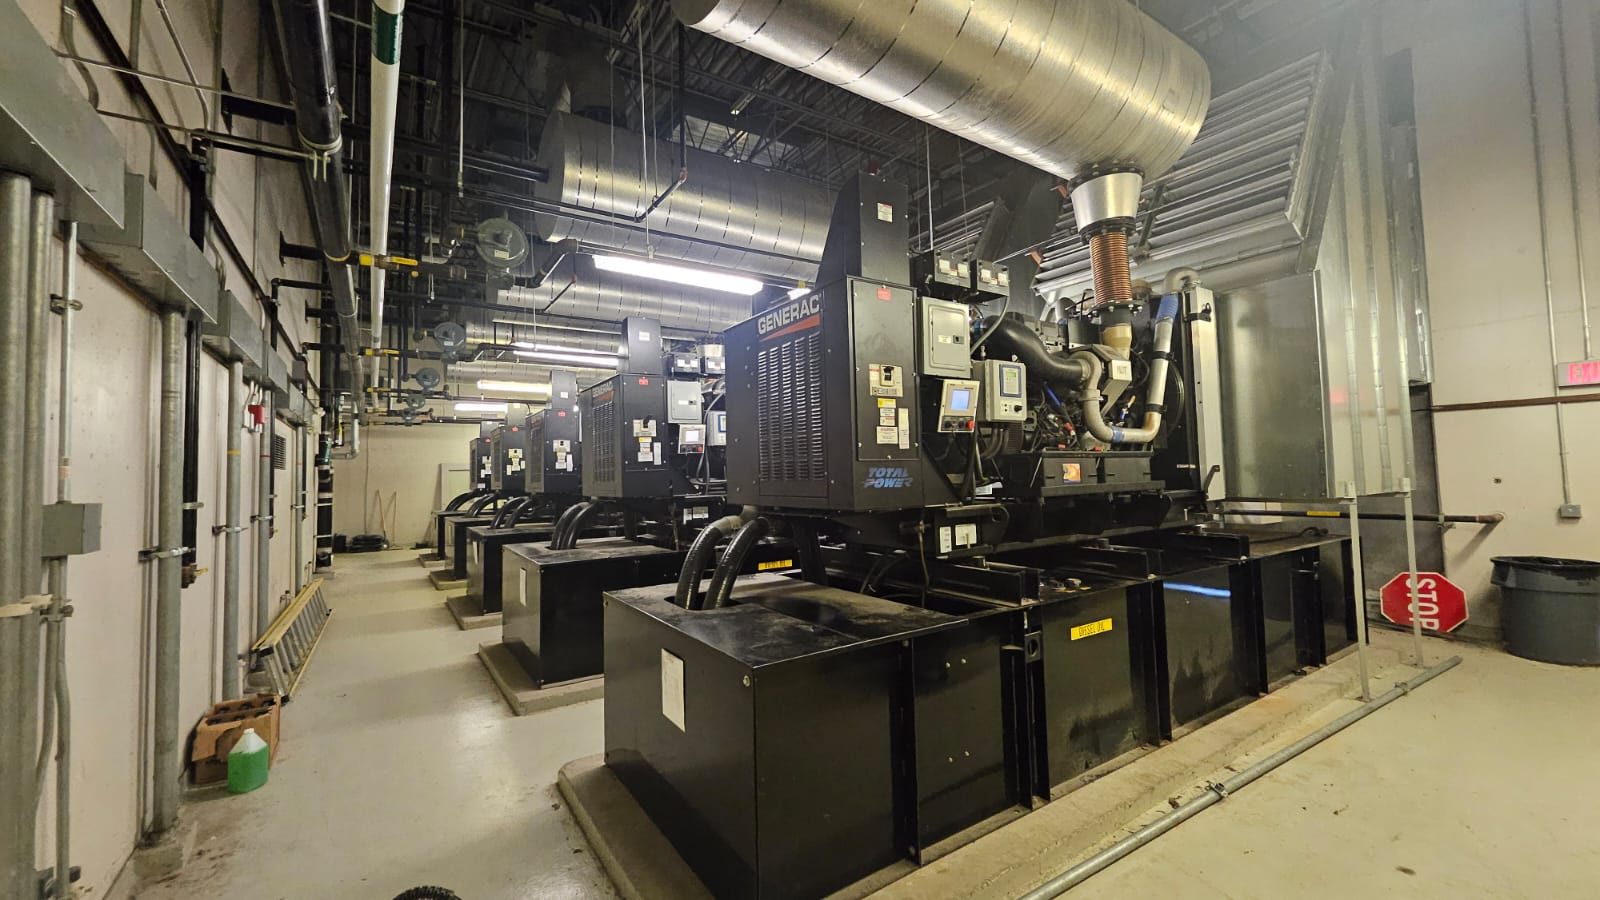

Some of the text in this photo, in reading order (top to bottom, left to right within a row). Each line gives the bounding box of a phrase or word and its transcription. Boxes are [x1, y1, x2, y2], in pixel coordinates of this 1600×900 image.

[758, 294, 820, 335] GENERAC
[1568, 361, 1600, 384] EXI
[863, 477, 913, 488] POWER
[868, 467, 908, 478] TOTAL
[1405, 578, 1439, 630] STOP
